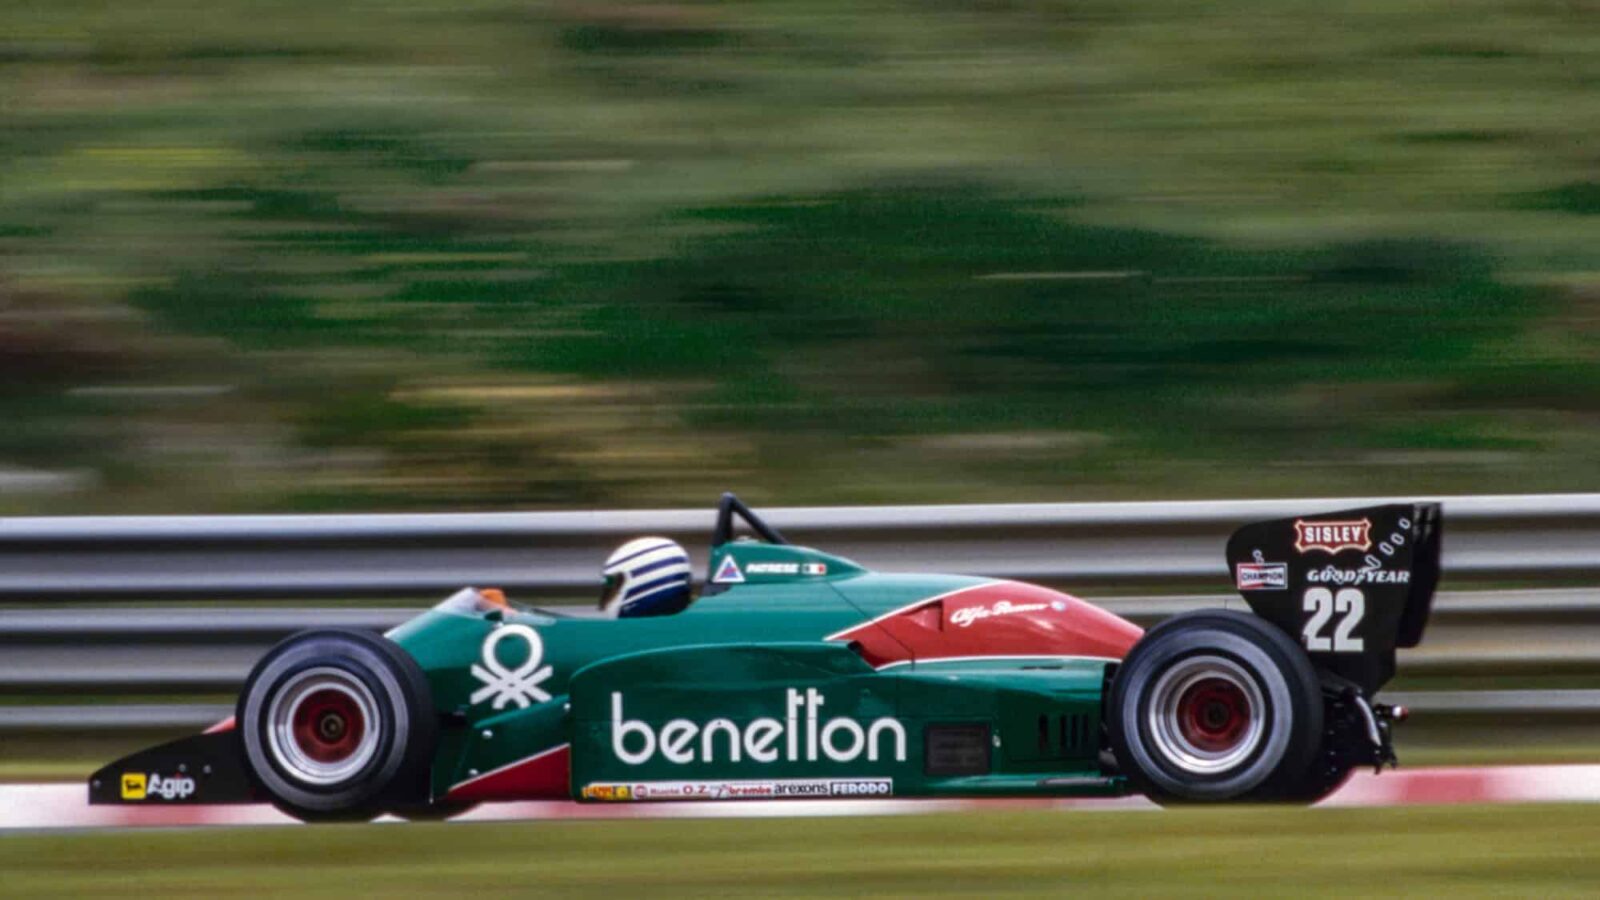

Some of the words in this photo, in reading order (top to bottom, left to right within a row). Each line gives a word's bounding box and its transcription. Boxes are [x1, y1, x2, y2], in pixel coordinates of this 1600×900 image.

[1304, 526, 1362, 542] SISLEY
[1242, 571, 1284, 581] CHAMPION
[1306, 567, 1410, 585] GOODYEAR
[1303, 587, 1365, 651] 22
[611, 688, 907, 765] benetton
[147, 774, 195, 798] Agip
[774, 781, 828, 795] arexons
[832, 783, 889, 795] FERODO
